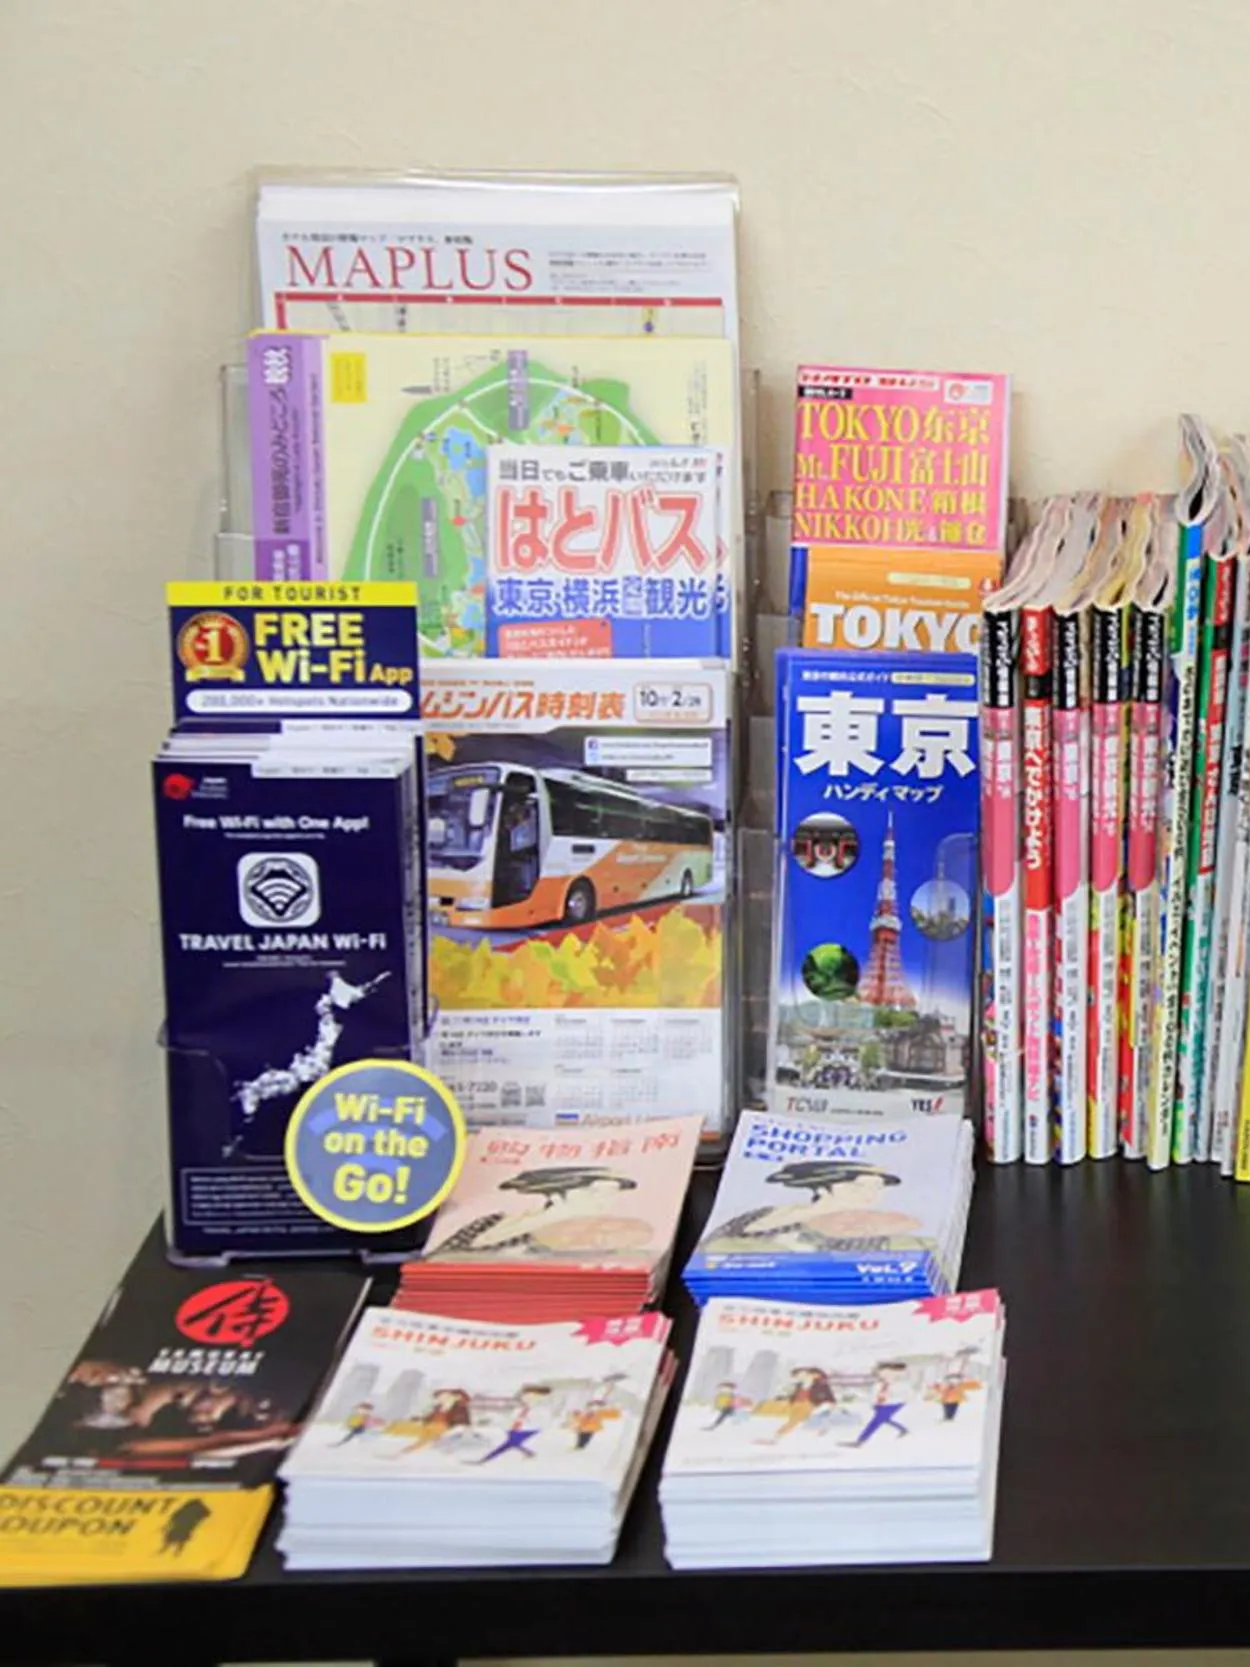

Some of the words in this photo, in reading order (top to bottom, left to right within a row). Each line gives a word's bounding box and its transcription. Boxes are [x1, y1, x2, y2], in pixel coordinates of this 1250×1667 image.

[286, 245, 533, 292] MAPLUS
[798, 401, 920, 443] TOKYO
[830, 443, 905, 484] FUJI
[795, 483, 925, 514] HAKONE
[496, 486, 711, 574] はとバス
[223, 587, 264, 601] FOR
[274, 587, 361, 601] TOURIST
[254, 612, 364, 647] FREE
[256, 649, 366, 683] Wi-Fi
[370, 663, 413, 685] App
[794, 690, 978, 778] 東京
[823, 782, 945, 803] ハンディマップ
[183, 814, 217, 829] Free
[219, 815, 260, 829] Wi-Fi
[263, 816, 295, 830] with
[298, 816, 329, 830] One
[179, 933, 254, 951] TRAVEL
[258, 933, 329, 951] JAPAN
[332, 932, 387, 950] Wi-Fi
[334, 1092, 428, 1125] Wi-Fi
[323, 1131, 365, 1154] on
[373, 1128, 429, 1159] the
[747, 1137, 865, 1158] PORTAL
[752, 1123, 908, 1146] SHOPPING
[332, 1162, 411, 1204] Go!
[719, 1313, 880, 1332] SHINJUKU
[371, 1325, 538, 1352] SHINJUKU
